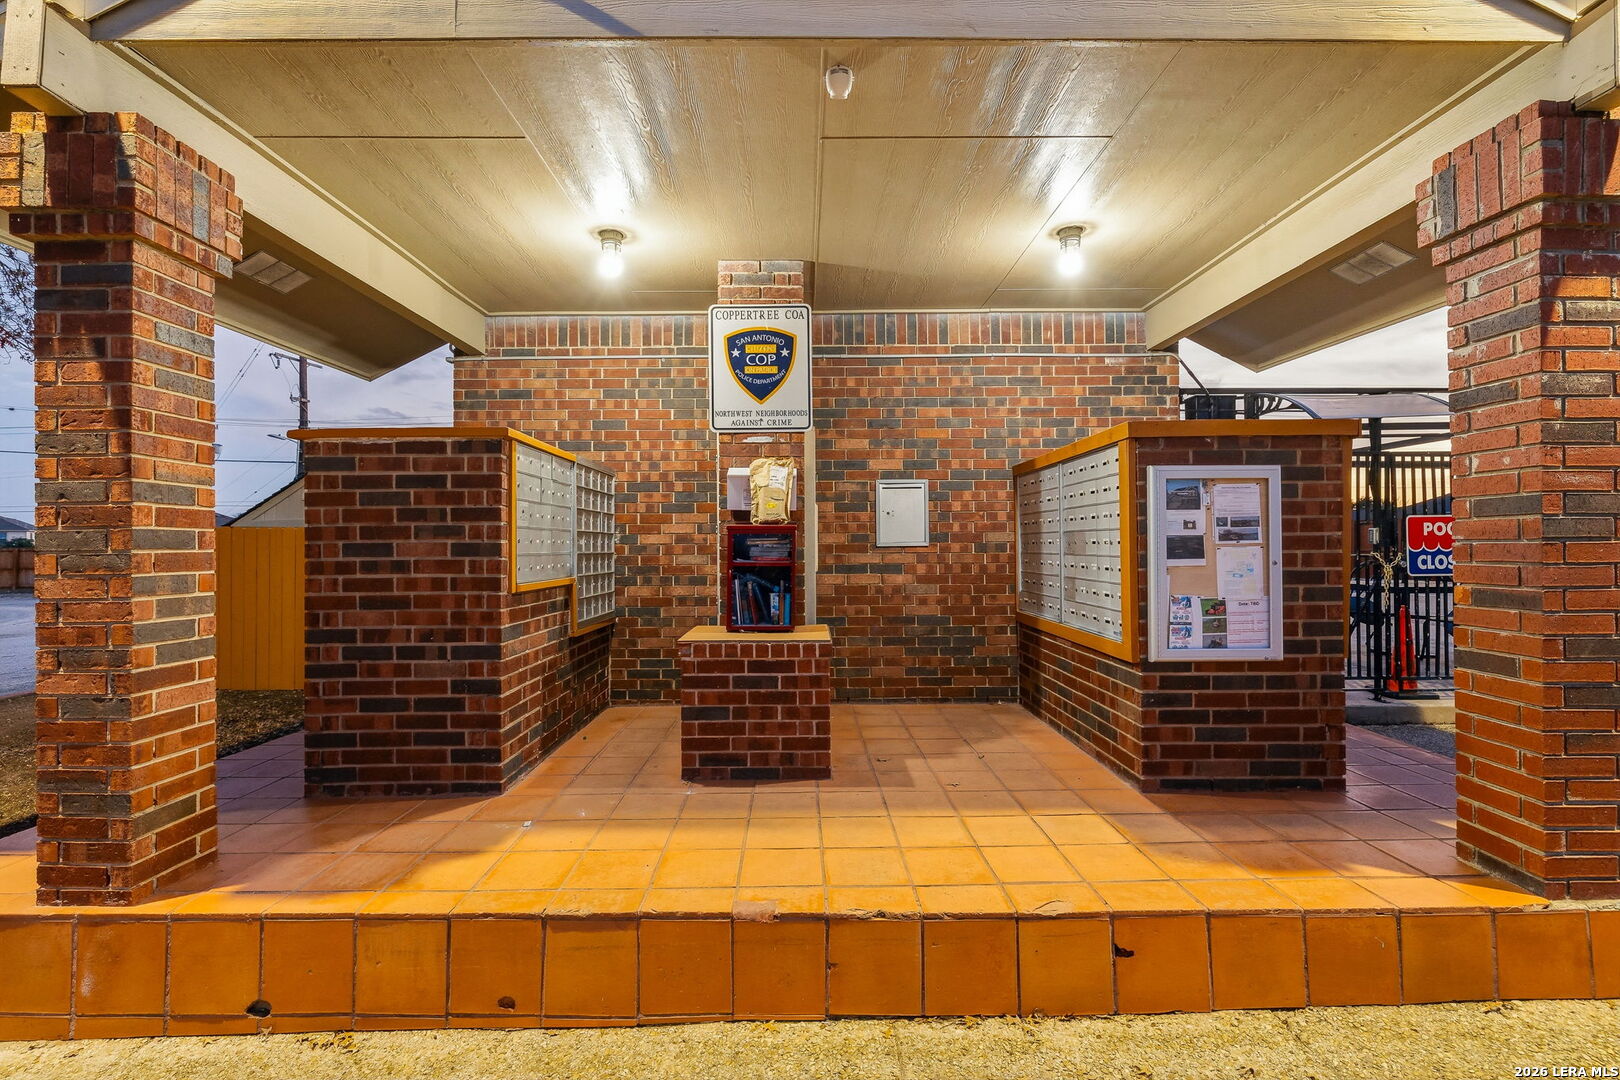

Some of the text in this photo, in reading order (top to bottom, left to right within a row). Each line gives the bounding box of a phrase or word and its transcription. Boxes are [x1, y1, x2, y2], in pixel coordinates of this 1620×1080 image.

[715, 310, 805, 320] COPPERTREE COA
[735, 334, 785, 346] SAN ANTONIO
[746, 354, 776, 365] COP
[735, 369, 786, 385] POLICE DEPARTMENT
[715, 409, 808, 418] NORTHWEST NEIGHBORHOODS
[731, 418, 763, 427] AGAINST
